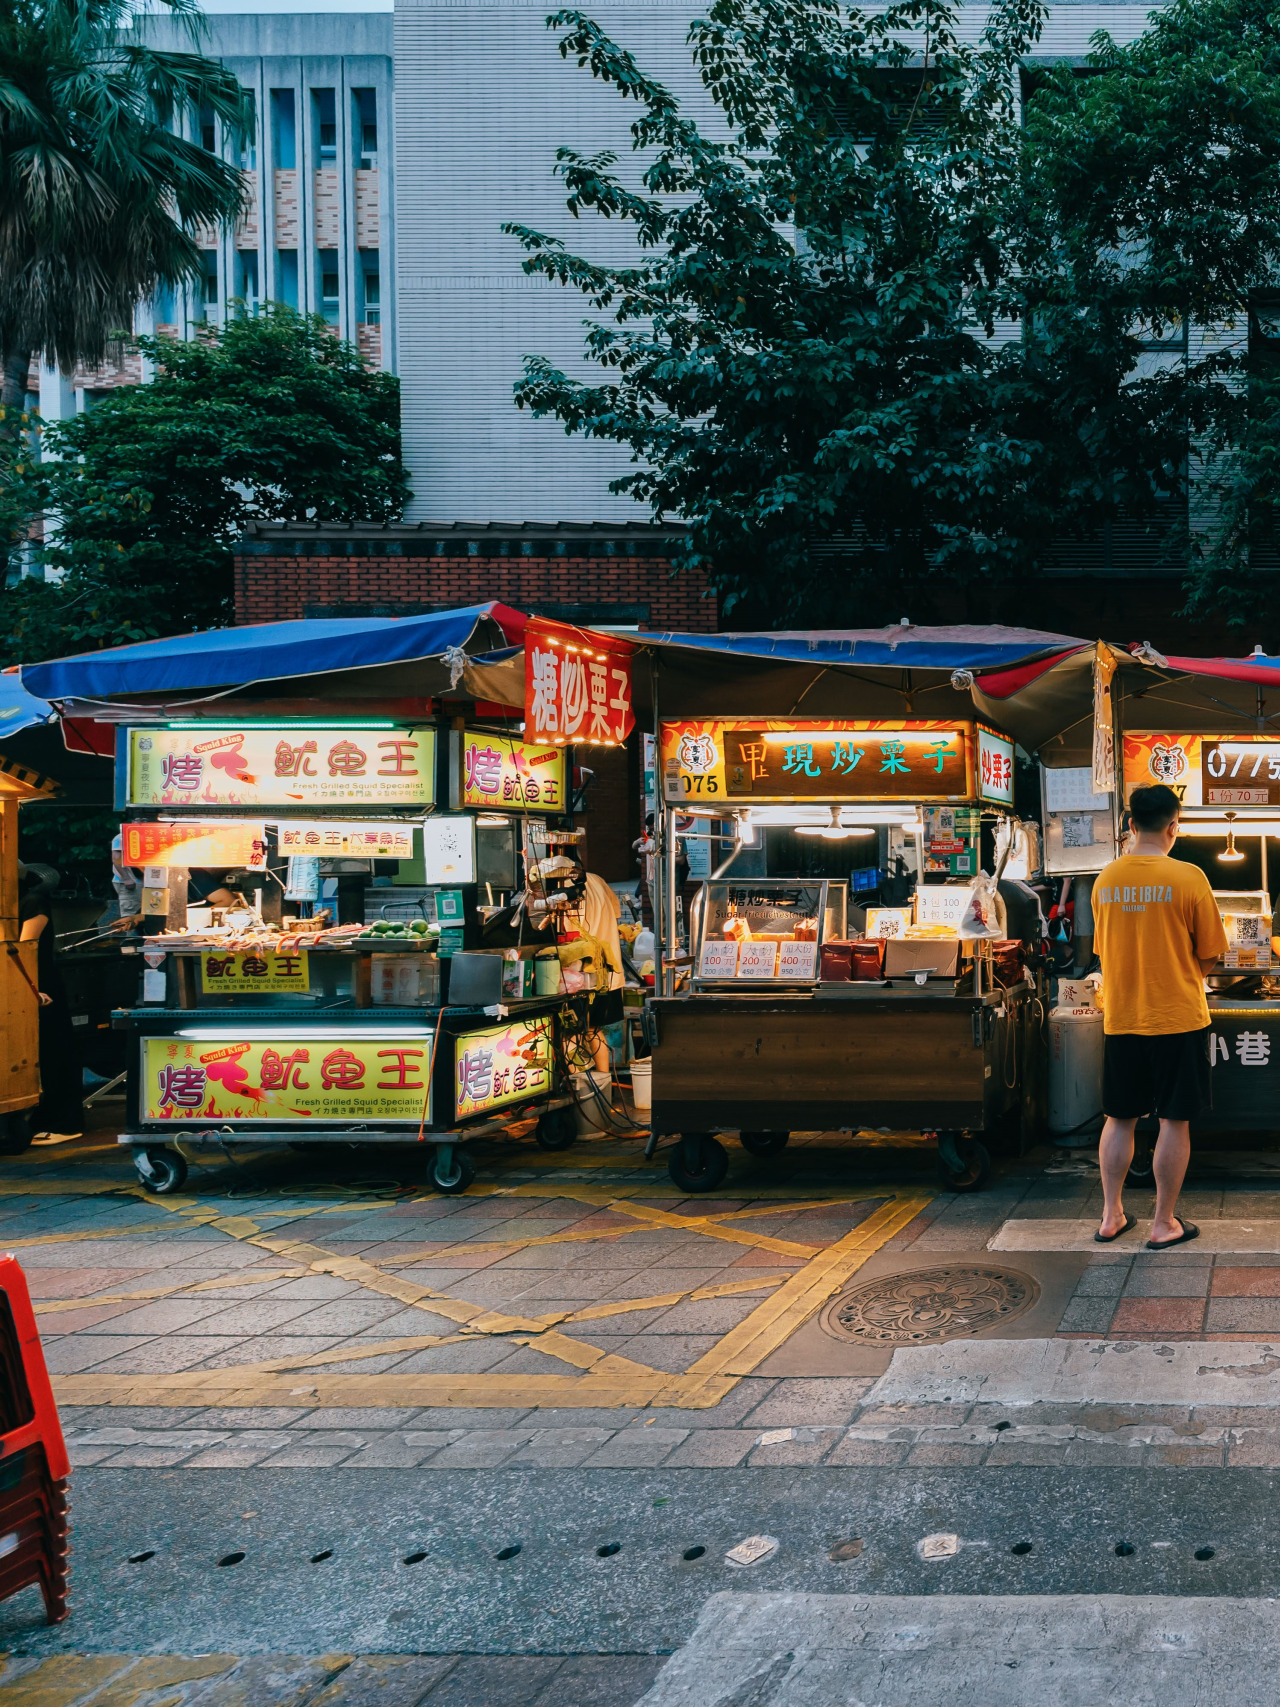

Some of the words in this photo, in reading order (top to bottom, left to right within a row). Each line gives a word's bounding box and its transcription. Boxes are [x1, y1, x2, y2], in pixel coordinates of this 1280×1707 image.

[532, 646, 629, 740] 糖炒栗子
[196, 740, 220, 753] Squid
[221, 734, 242, 746] King
[690, 745, 703, 766] 寧夏
[781, 738, 957, 777] 現炒栗子
[161, 752, 205, 792] 烤
[275, 739, 419, 777] 魷魚王
[465, 743, 502, 795] 烤
[503, 773, 559, 804] 魷魚王
[981, 747, 1012, 791] 炒栗子
[1161, 755, 1174, 776] 寧夏
[352, 782, 378, 790] Squid
[380, 782, 423, 790] Specialist
[1210, 791, 1215, 801] 1
[1220, 790, 1234, 803] 份
[1237, 791, 1251, 801] 70
[1254, 790, 1268, 803] 元
[283, 830, 341, 845] 魷魚王
[727, 889, 803, 907] 糖炒栗子
[931, 898, 940, 907] 包
[1098, 886, 1121, 905] ISLA
[1123, 886, 1137, 903] DE
[1139, 885, 1172, 903] IBIZA
[715, 909, 742, 918] Sugar
[206, 955, 303, 978] 魷魚王
[704, 956, 721, 965] 100
[723, 955, 735, 966] 元
[742, 956, 760, 965] 200
[762, 955, 773, 967] 元
[781, 956, 799, 965] 400
[801, 955, 812, 967] 元
[167, 1044, 196, 1059] 寧夏
[202, 1050, 227, 1062] Squid
[227, 1043, 249, 1055] King
[158, 1064, 207, 1108] 烤
[260, 1048, 424, 1090] 魷魚王
[457, 1048, 494, 1104] 烤
[296, 1098, 320, 1106] Fresh
[323, 1098, 351, 1106] Grilled
[353, 1098, 378, 1107] Squid
[380, 1098, 423, 1107] Specialist
